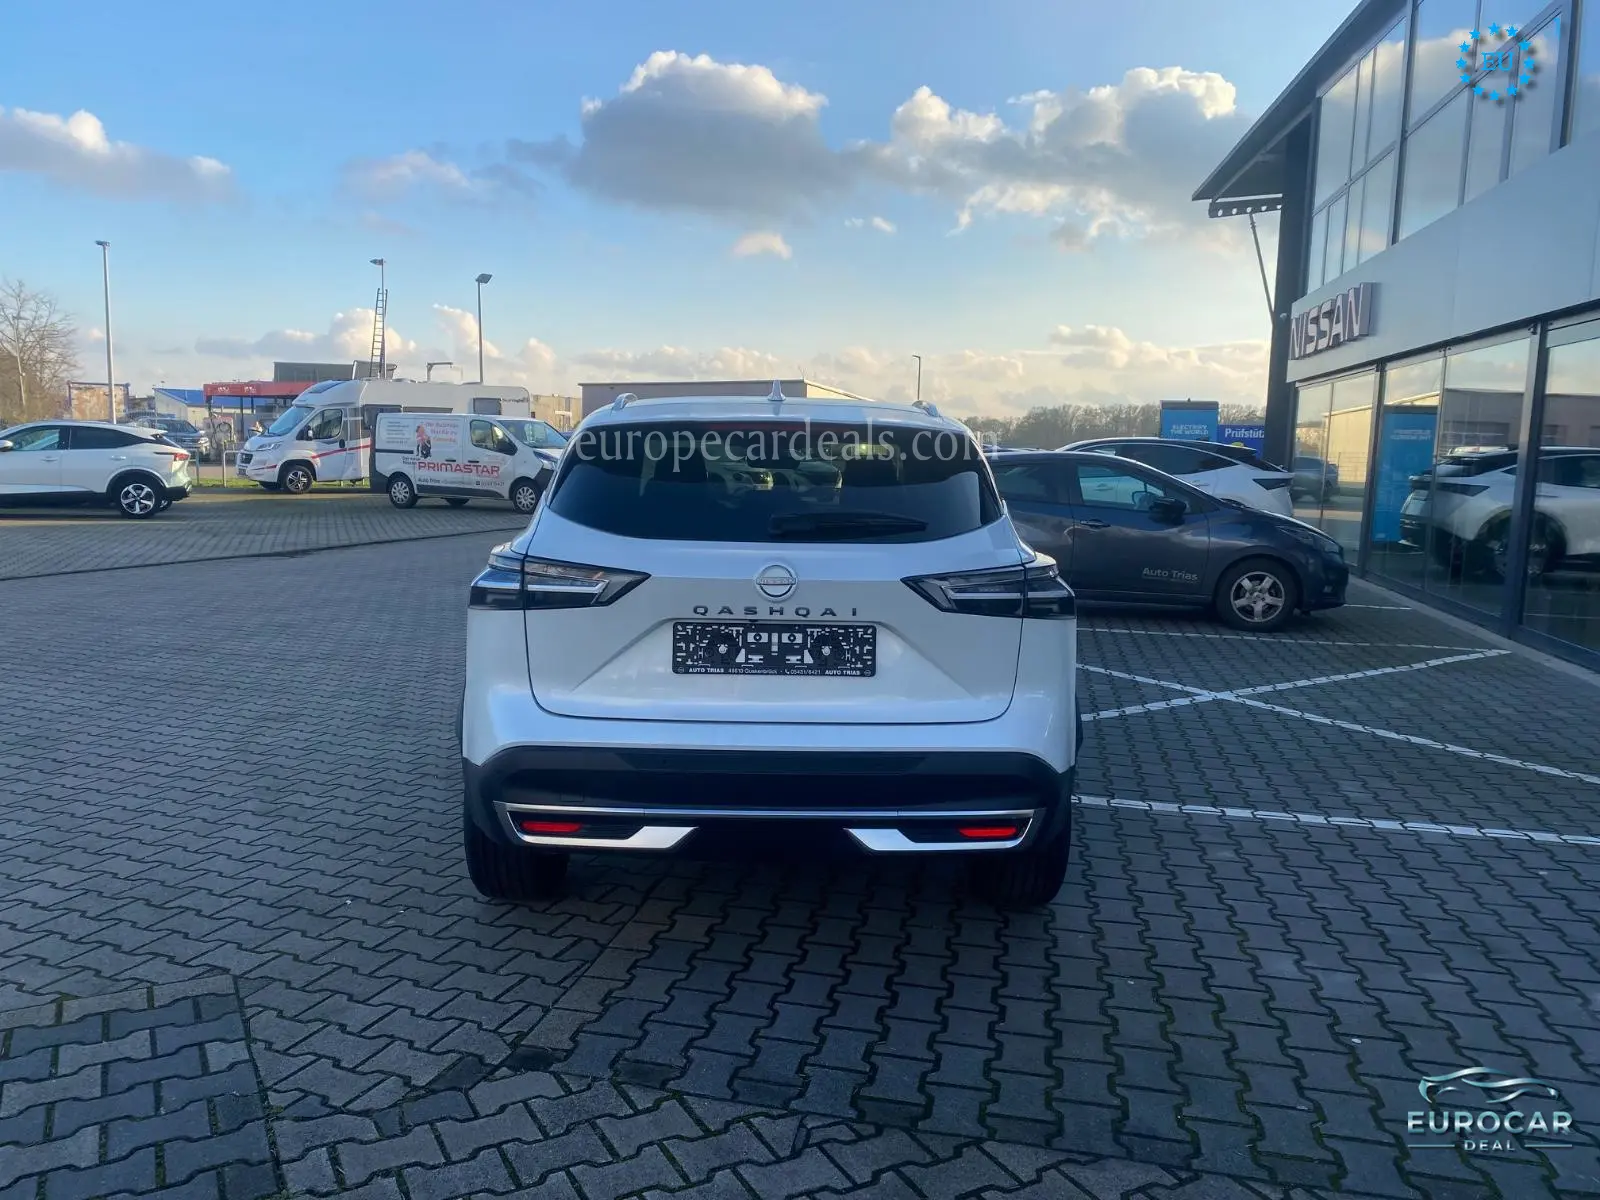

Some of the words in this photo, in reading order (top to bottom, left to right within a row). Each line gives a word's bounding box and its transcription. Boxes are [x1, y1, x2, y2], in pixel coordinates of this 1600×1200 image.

[1290, 282, 1372, 360] NISSAN
[418, 461, 500, 475] PRIMASTAR
[1142, 567, 1169, 577] Auto
[1172, 570, 1198, 581] Trias
[693, 606, 857, 617] QASHQAI
